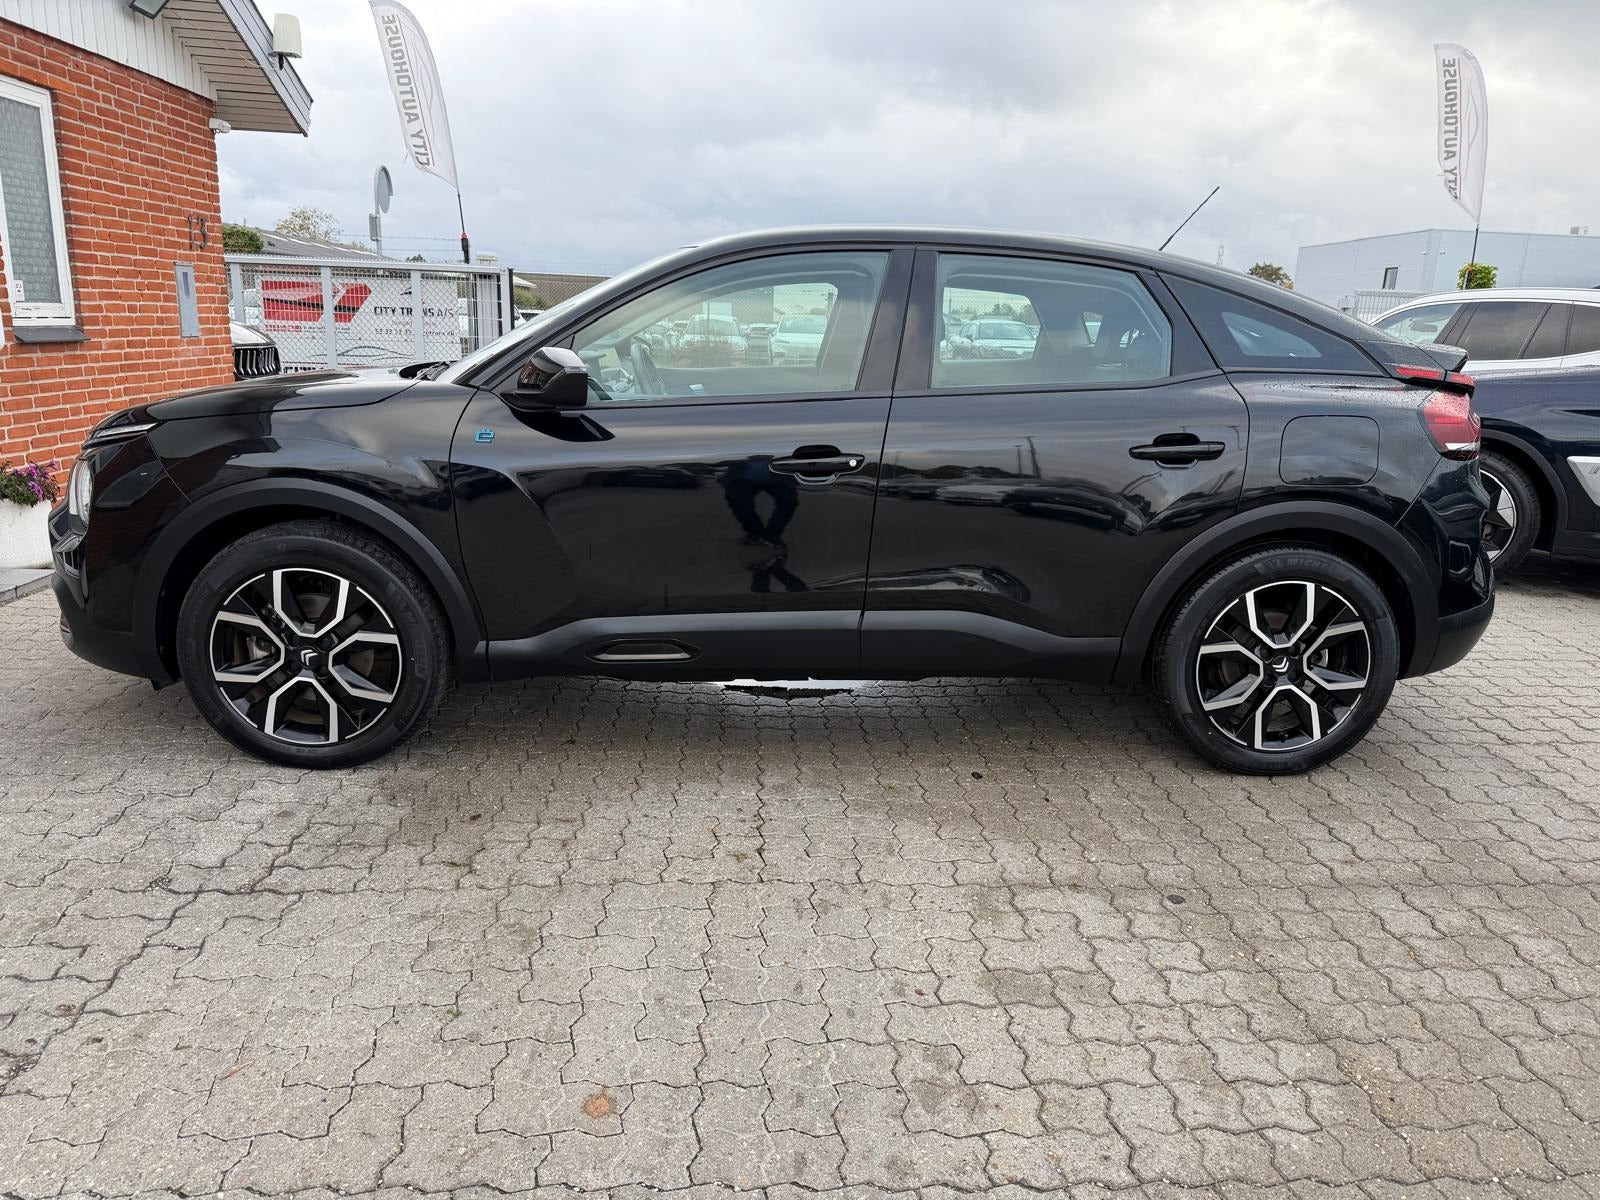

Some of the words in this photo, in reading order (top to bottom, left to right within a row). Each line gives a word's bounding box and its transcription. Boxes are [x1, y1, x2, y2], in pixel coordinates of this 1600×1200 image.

[188, 215, 208, 250] 13
[373, 306, 396, 316] CITY
[400, 307, 435, 317] TRNS
